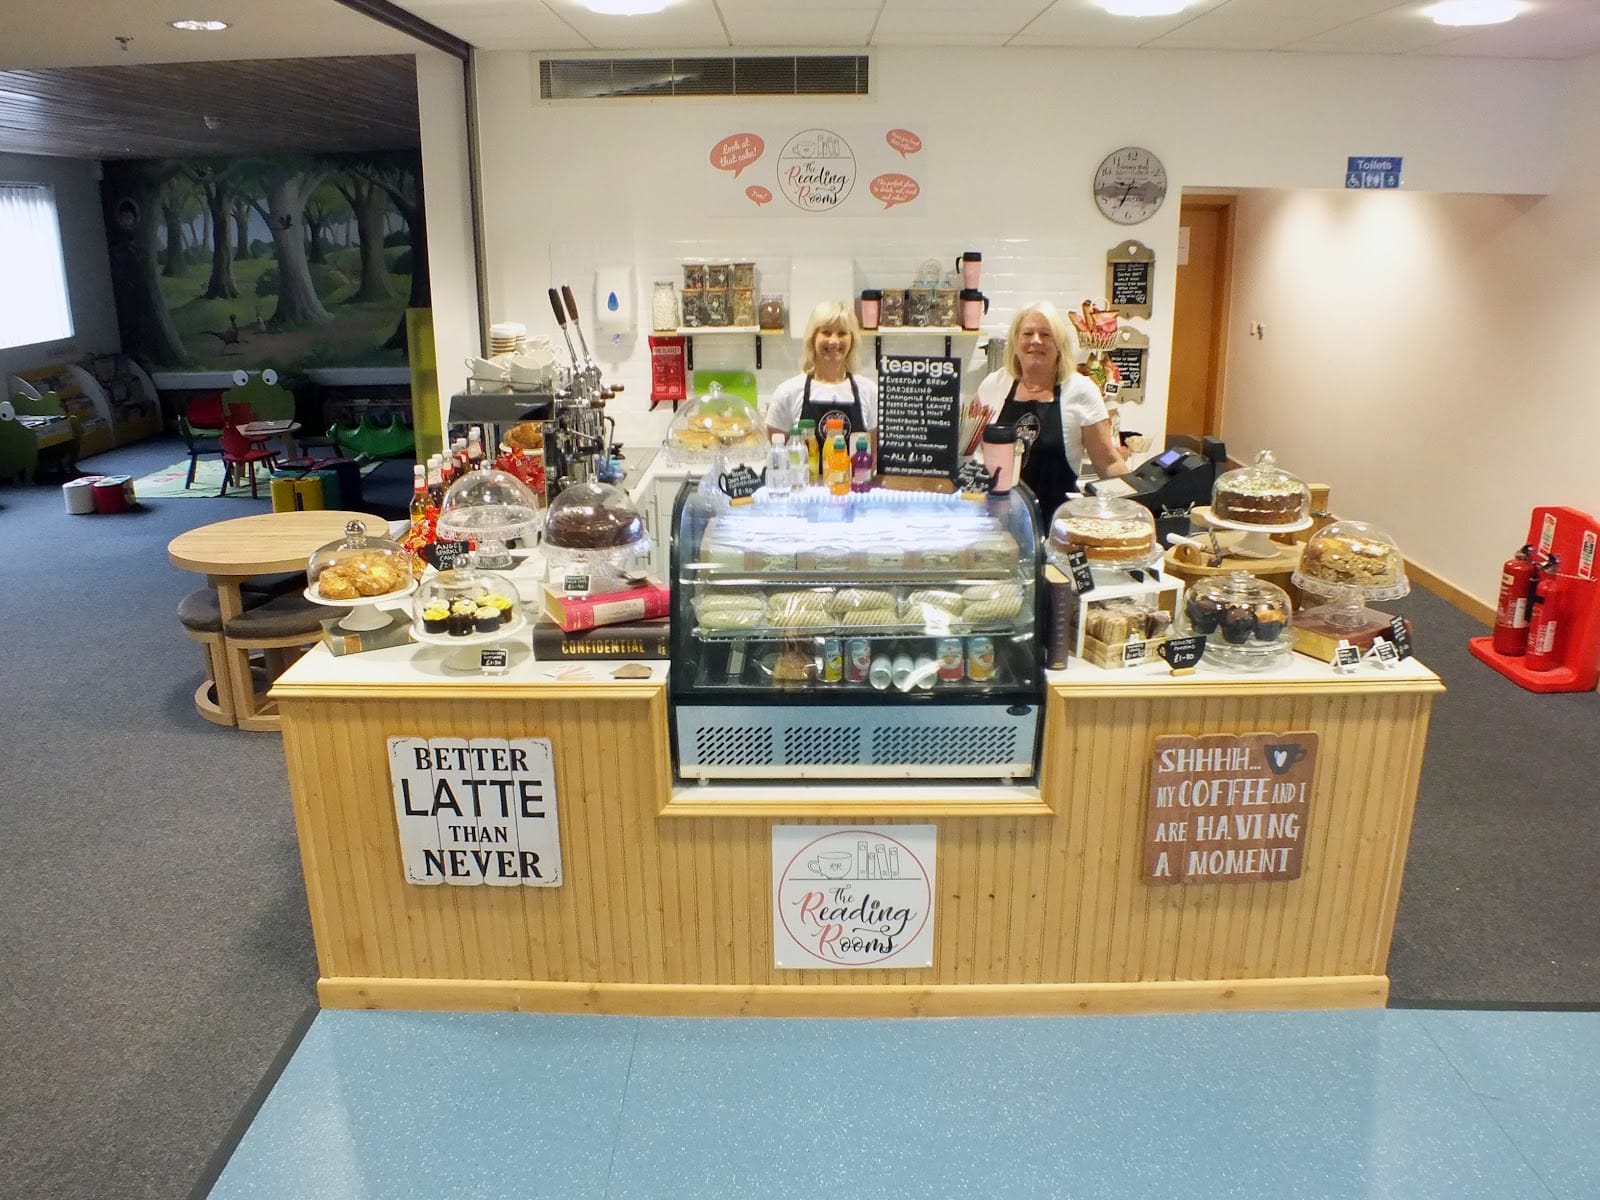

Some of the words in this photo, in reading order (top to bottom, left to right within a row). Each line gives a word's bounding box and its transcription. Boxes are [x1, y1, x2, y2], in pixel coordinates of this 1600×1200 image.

[720, 154, 737, 167] that
[738, 147, 757, 161] cake!
[722, 140, 742, 154] Look
[1357, 160, 1392, 170] Toilets
[784, 165, 849, 193] Reading
[794, 185, 839, 208] Rooms
[880, 355, 958, 378] teapigs.
[886, 385, 932, 393] DARJEELING
[886, 393, 923, 401] CHAMOMILE
[906, 425, 928, 433] FRUITS
[561, 639, 646, 655] CONFIDENTIAL
[413, 747, 529, 772] BETTER
[400, 778, 546, 819] LATTE
[1156, 786, 1176, 808] MY
[1178, 778, 1271, 808] COFFEE
[1271, 783, 1297, 804] AND
[1298, 782, 1307, 803] I
[448, 825, 508, 843] THAN
[1154, 822, 1189, 842] ARE
[1196, 813, 1301, 842] HAVING
[422, 849, 543, 878] NEVER
[1152, 851, 1172, 877] A
[1187, 847, 1293, 876] MOMENT
[829, 883, 855, 905] The
[792, 891, 917, 937] Reading
[811, 922, 898, 960] Rooms
